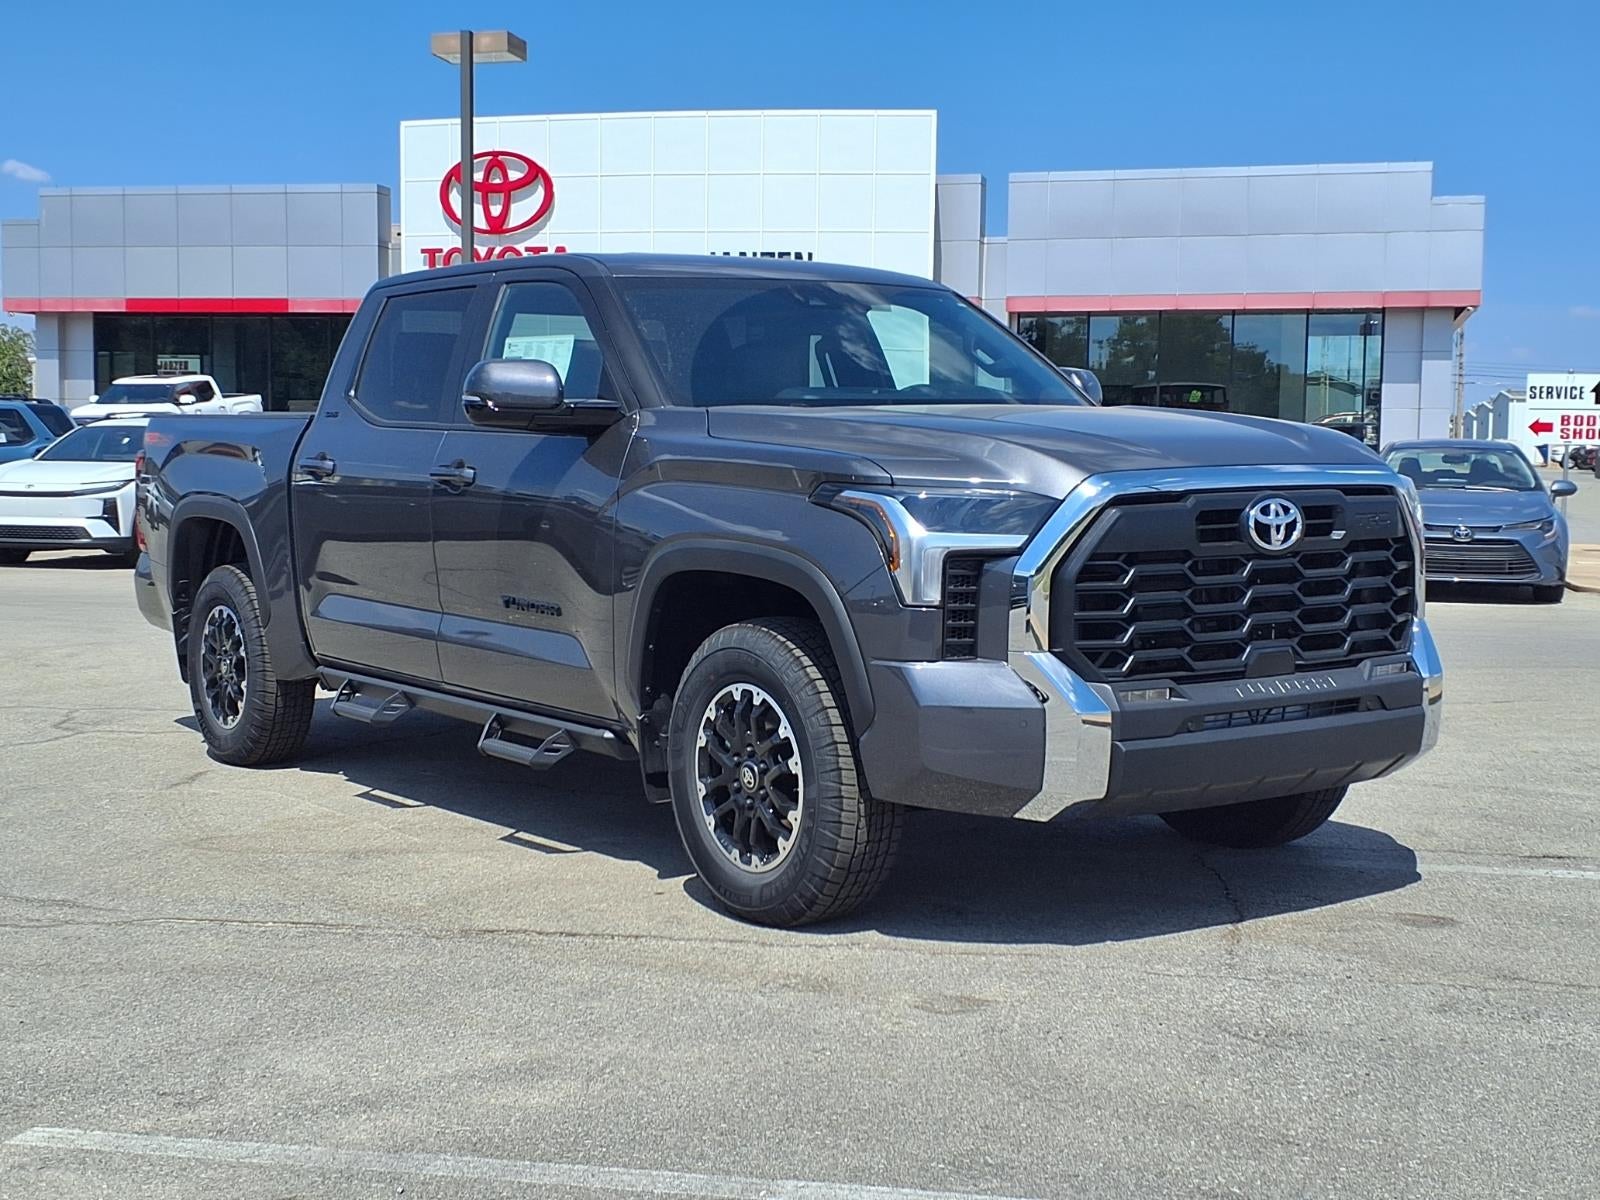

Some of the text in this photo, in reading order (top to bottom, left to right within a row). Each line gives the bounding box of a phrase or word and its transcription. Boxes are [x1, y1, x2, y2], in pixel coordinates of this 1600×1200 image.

[1529, 385, 1585, 400] SERVICE
[1560, 415, 1600, 427] BOD
[1560, 428, 1600, 440] SHO
